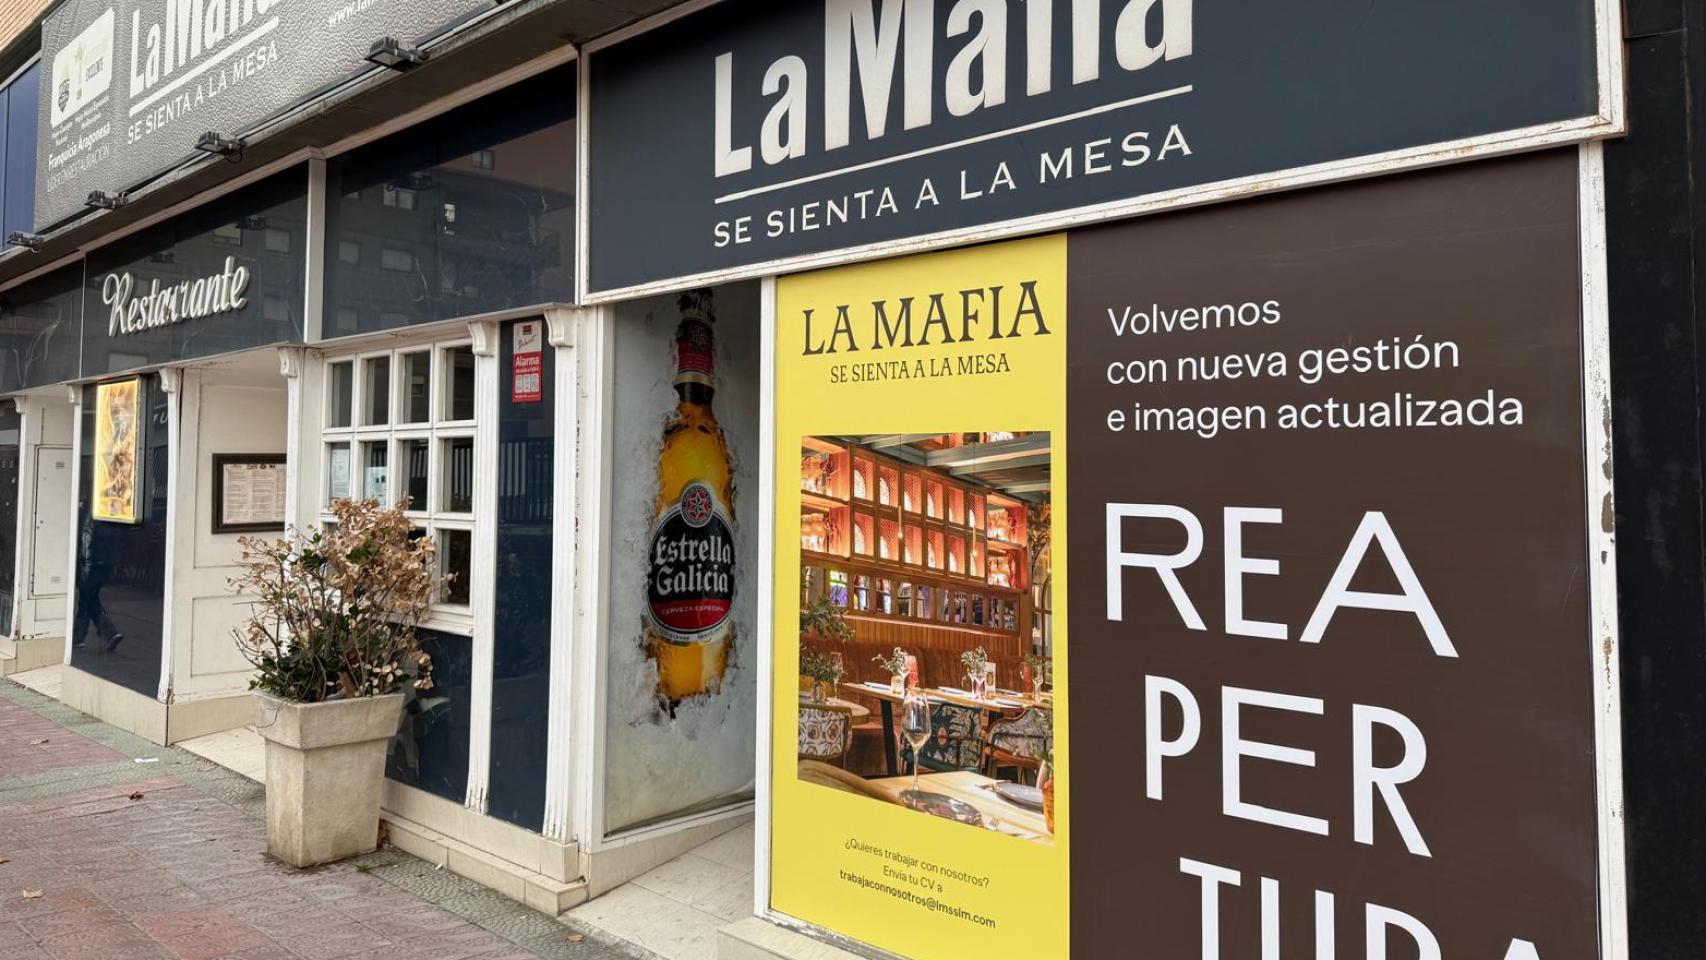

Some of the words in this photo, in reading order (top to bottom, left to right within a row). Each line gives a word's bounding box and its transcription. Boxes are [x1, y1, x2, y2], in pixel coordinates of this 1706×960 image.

[127, 120, 143, 145] SE
[145, 92, 191, 134] SIENTA
[194, 84, 204, 107] A
[208, 70, 227, 98] LA
[232, 40, 278, 84] MESA
[714, 216, 752, 248] SE
[767, 186, 899, 238] SIENTA
[915, 178, 941, 209] A
[960, 162, 1017, 200] LA
[1040, 124, 1193, 184] MESA
[102, 255, 250, 337] Restaurante
[802, 304, 860, 356] LA
[871, 280, 1052, 350] MAFIA
[1107, 299, 1281, 337] Volvemos
[830, 365, 849, 383] SE
[852, 360, 910, 382] SIENTA
[913, 359, 926, 378] A
[930, 357, 953, 377] LA
[957, 353, 1010, 376] MESA
[1107, 358, 1167, 384] con
[1177, 351, 1288, 381] nueva
[1298, 334, 1459, 384] gestión
[1107, 407, 1126, 432] e
[1134, 402, 1267, 438] imagen
[1277, 389, 1524, 429] actualizada
[654, 532, 732, 566] Estrella
[656, 563, 729, 596] Galicia
[1106, 502, 1459, 658] REA
[1145, 674, 1432, 858] PER
[844, 838, 883, 857] ¿Quieres
[885, 850, 919, 868] trabajar
[921, 860, 939, 874] con
[940, 866, 989, 889] nosotros?
[909, 873, 919, 886] tu
[920, 877, 935, 890] CV
[937, 883, 943, 893] a
[1179, 856, 1540, 960] TU
